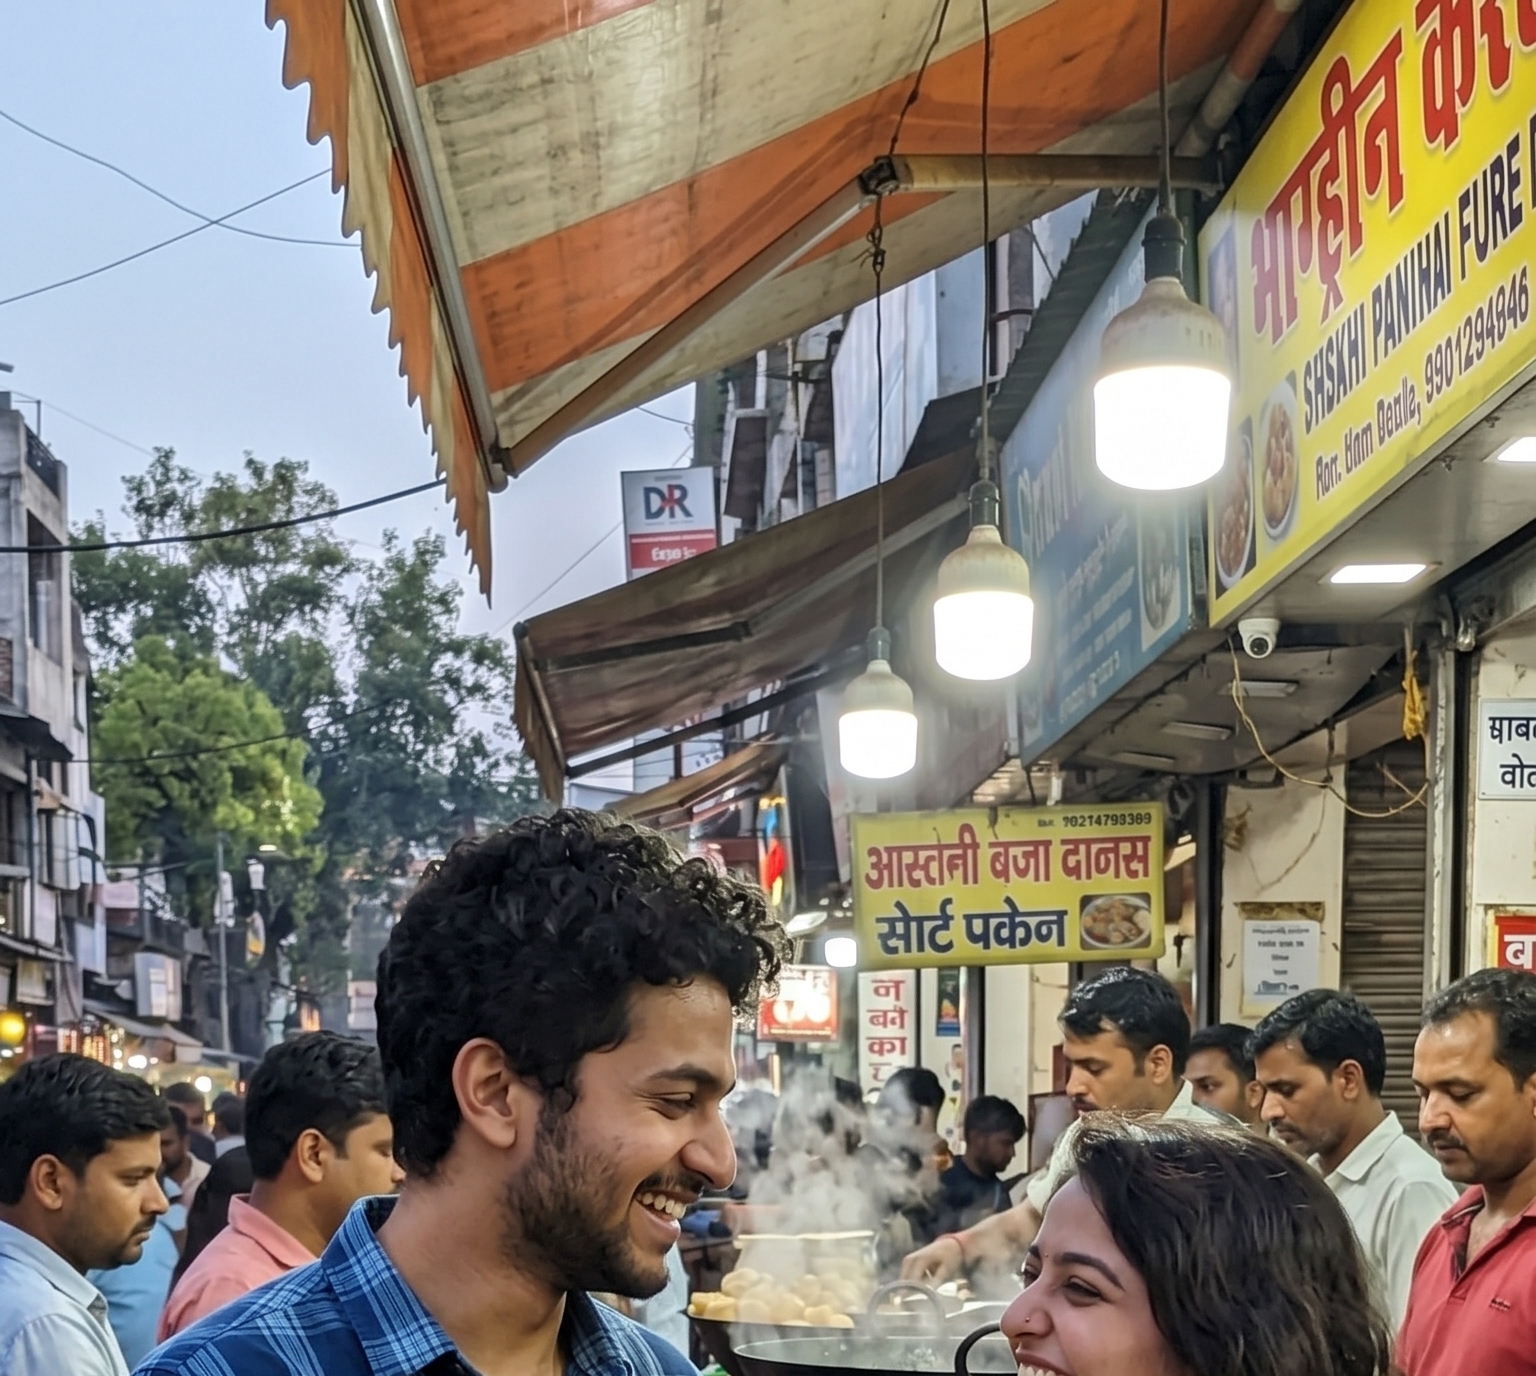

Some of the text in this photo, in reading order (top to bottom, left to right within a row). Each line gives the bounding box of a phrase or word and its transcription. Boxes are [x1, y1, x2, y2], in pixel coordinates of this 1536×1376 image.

[1304, 132, 1523, 436] SHSKHI PANIHAI FURE
[643, 484, 694, 520] DR
[1060, 835, 1151, 881] दानस
[962, 895, 1068, 950] पकेन
